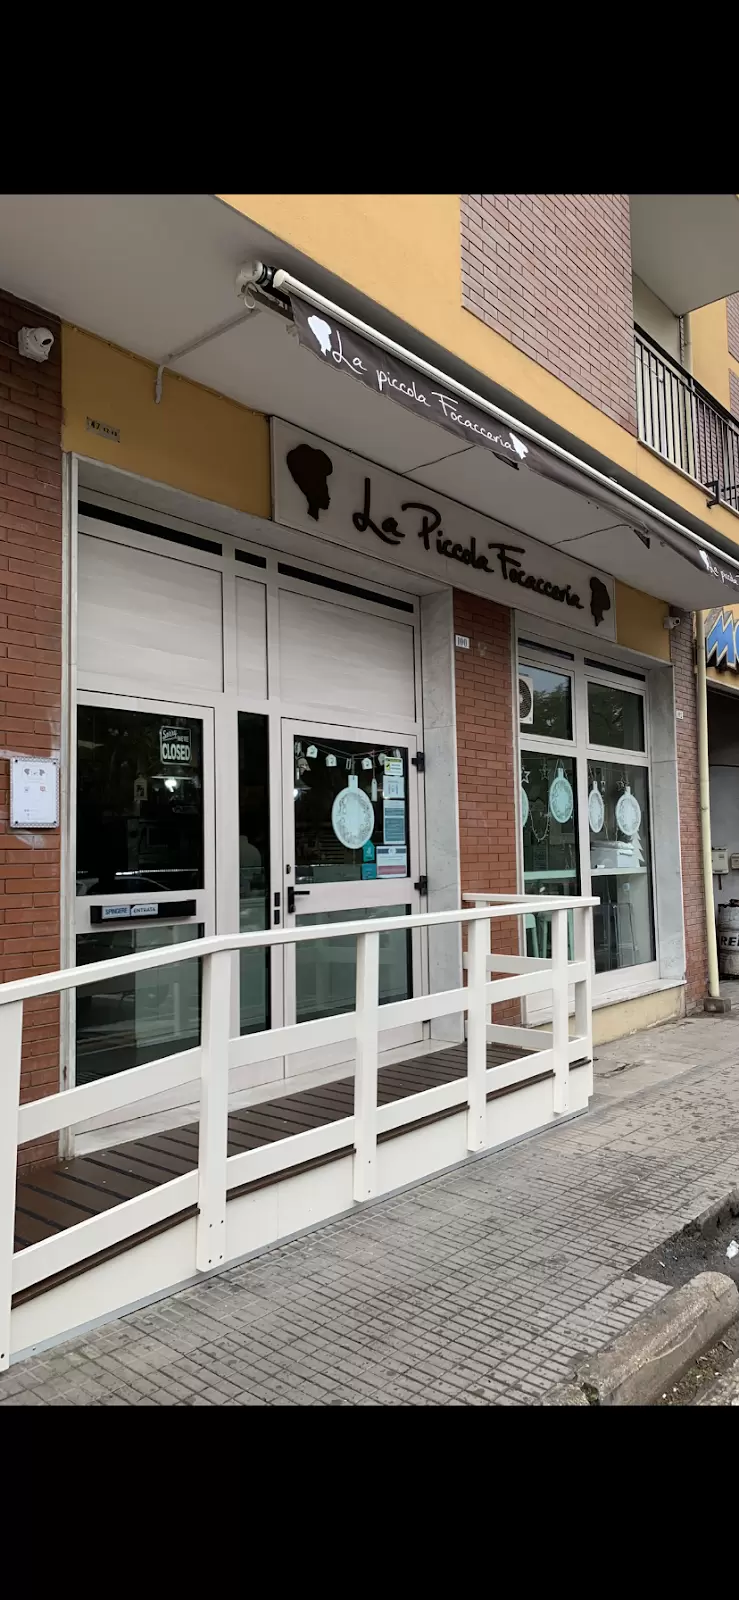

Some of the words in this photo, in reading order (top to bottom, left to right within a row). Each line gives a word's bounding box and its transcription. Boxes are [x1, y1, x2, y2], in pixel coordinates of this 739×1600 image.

[332, 330, 367, 375] La
[376, 369, 431, 407] piccola
[431, 391, 516, 452] Focacceria
[352, 478, 405, 545] La
[401, 502, 494, 573] Piccola
[488, 543, 584, 610] Focacceria
[162, 743, 191, 761] CLOSED
[105, 907, 128, 916] SPINGERE
[133, 906, 156, 914] ENTRATA
